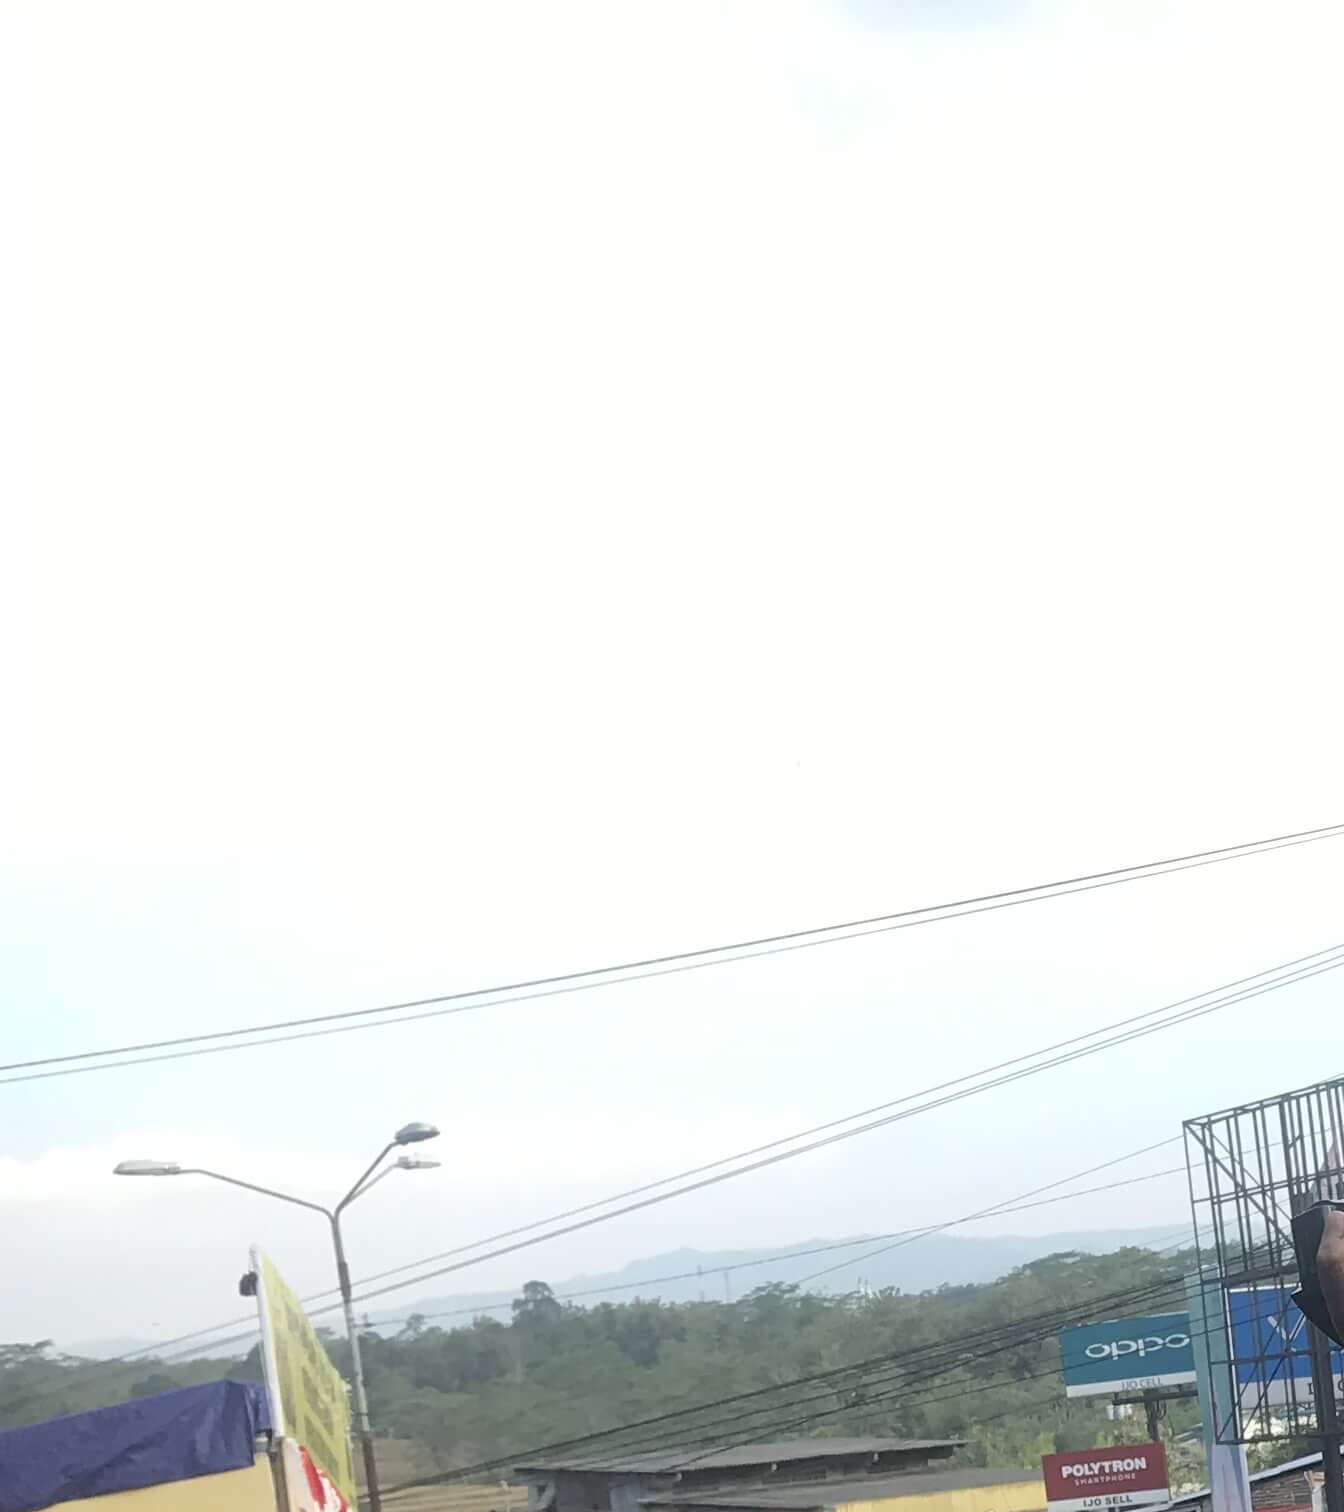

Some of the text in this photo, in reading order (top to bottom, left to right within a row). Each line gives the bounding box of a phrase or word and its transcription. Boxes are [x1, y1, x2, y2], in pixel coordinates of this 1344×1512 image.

[1061, 1456, 1147, 1478] POLYTRON
[1074, 1472, 1136, 1486] SMARTPHONE
[1106, 1495, 1133, 1506] SELL
